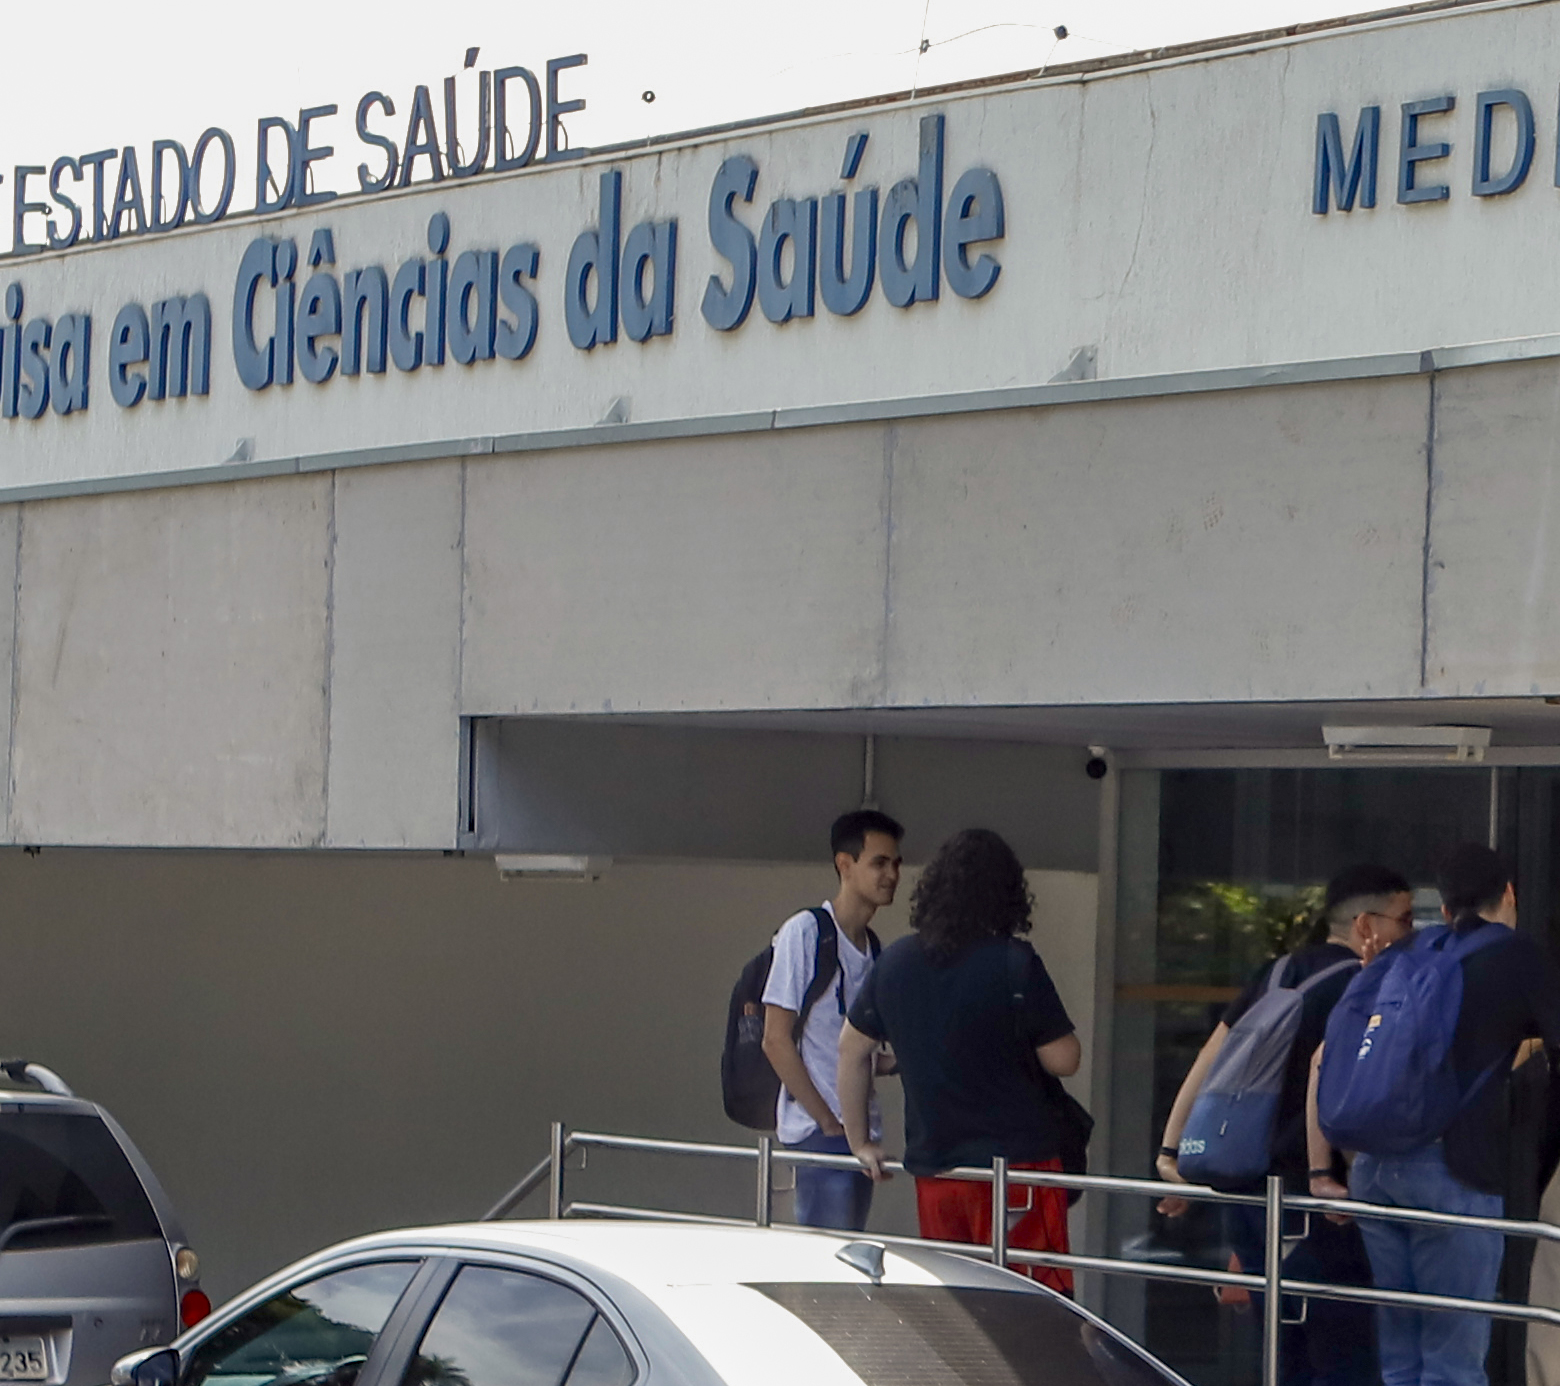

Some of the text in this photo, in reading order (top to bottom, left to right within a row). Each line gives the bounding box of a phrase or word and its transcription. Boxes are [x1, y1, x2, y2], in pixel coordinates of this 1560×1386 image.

[13, 126, 237, 254] ESTADO
[254, 104, 337, 212] DE
[355, 47, 587, 194] SAÚDE
[107, 290, 211, 409] em
[232, 213, 539, 392] Ciências
[565, 169, 679, 351] da
[702, 113, 1005, 332] Saúde
